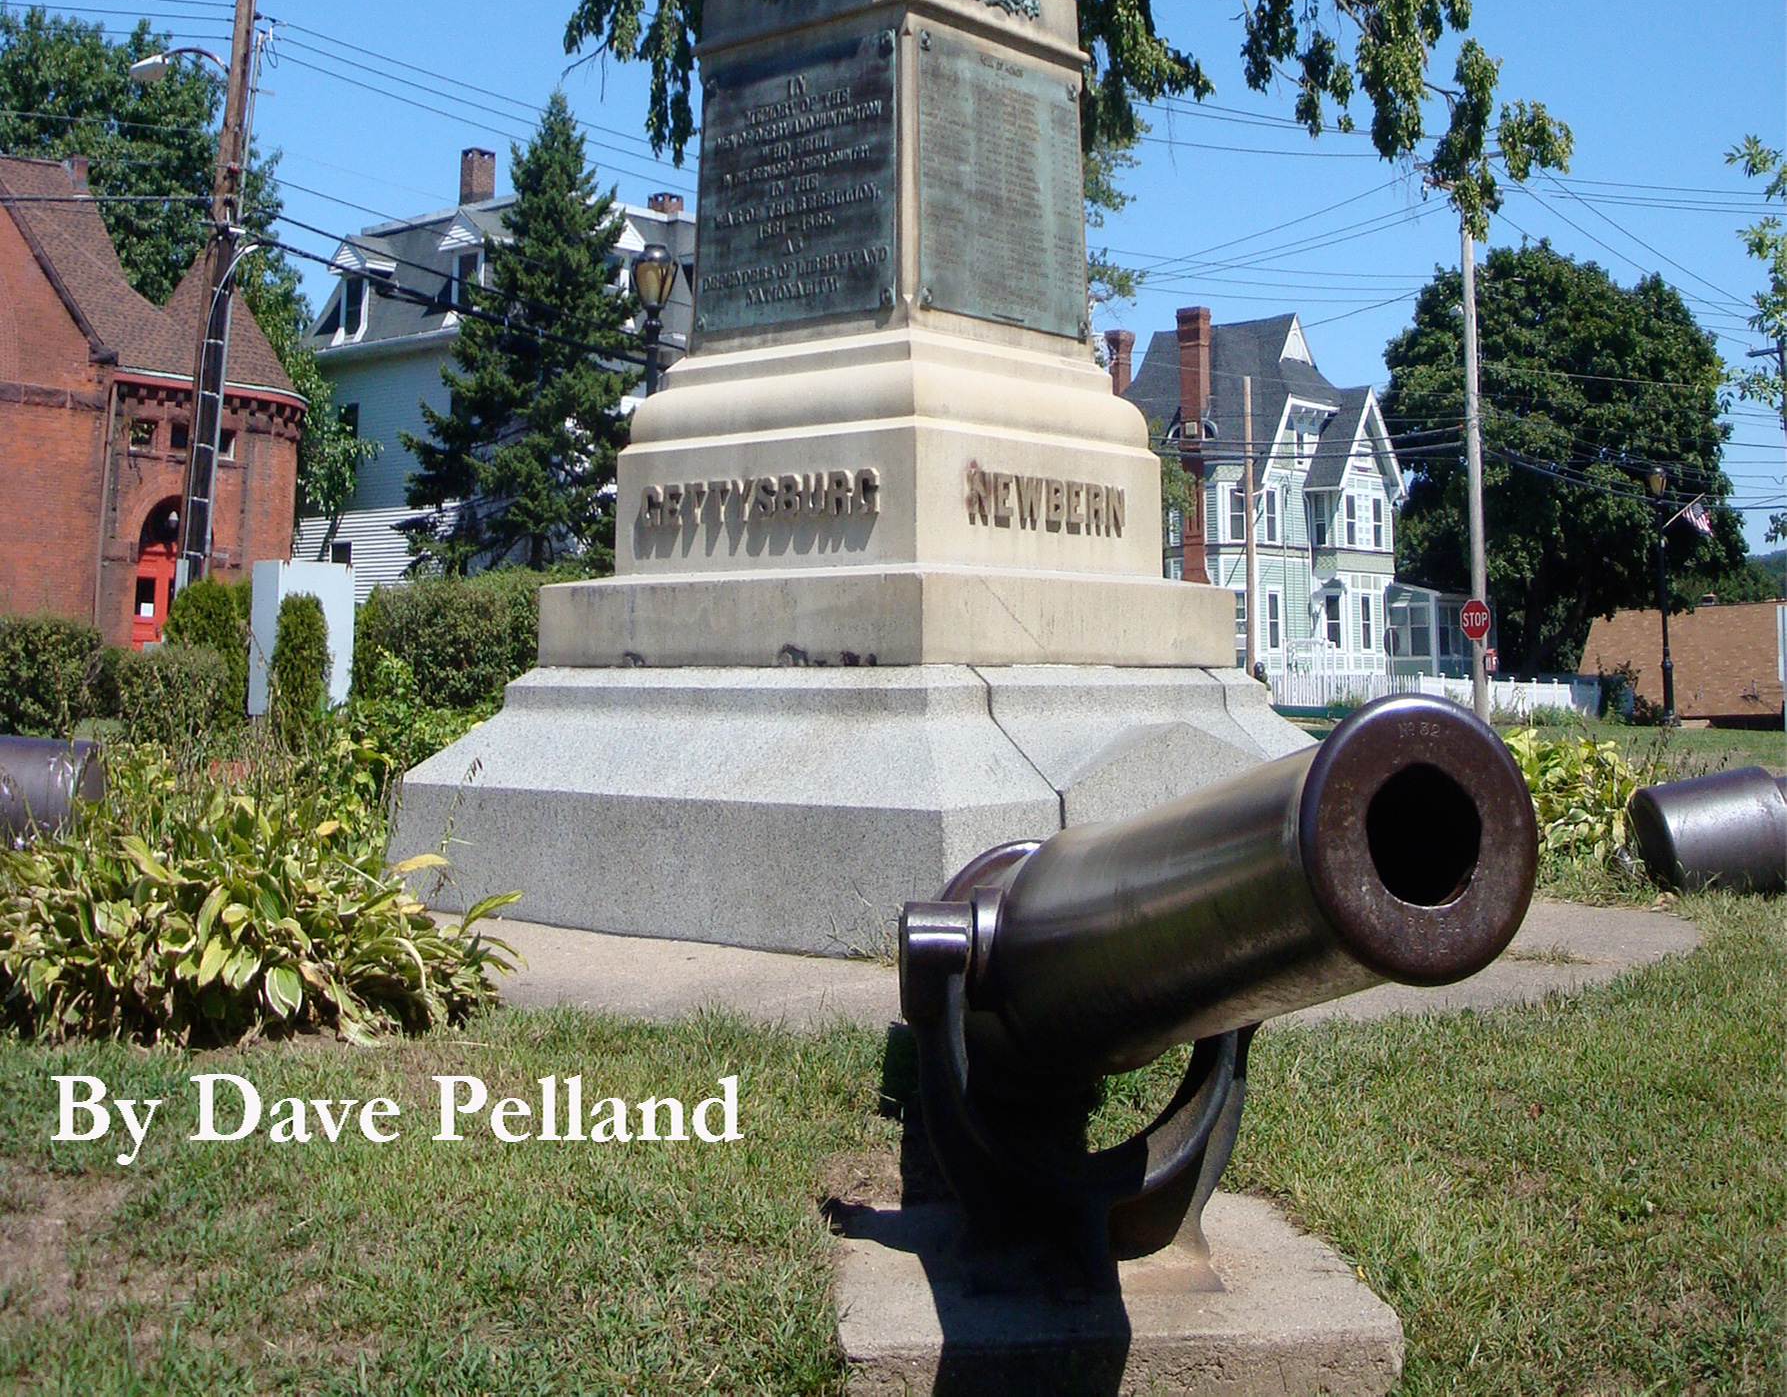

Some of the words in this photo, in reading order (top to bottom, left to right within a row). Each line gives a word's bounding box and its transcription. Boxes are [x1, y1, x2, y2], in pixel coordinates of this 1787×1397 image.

[787, 73, 807, 97] IN
[745, 100, 797, 126] MEMORY
[799, 94, 818, 113] OF
[822, 86, 851, 108] THE
[770, 179, 786, 198] IN
[791, 173, 819, 193] THE
[767, 197, 796, 219] THE
[860, 243, 890, 267] AND
[641, 467, 881, 528] GETTYSBURG
[966, 469, 1126, 529] NEWBERN
[1462, 611, 1488, 628] STOP
